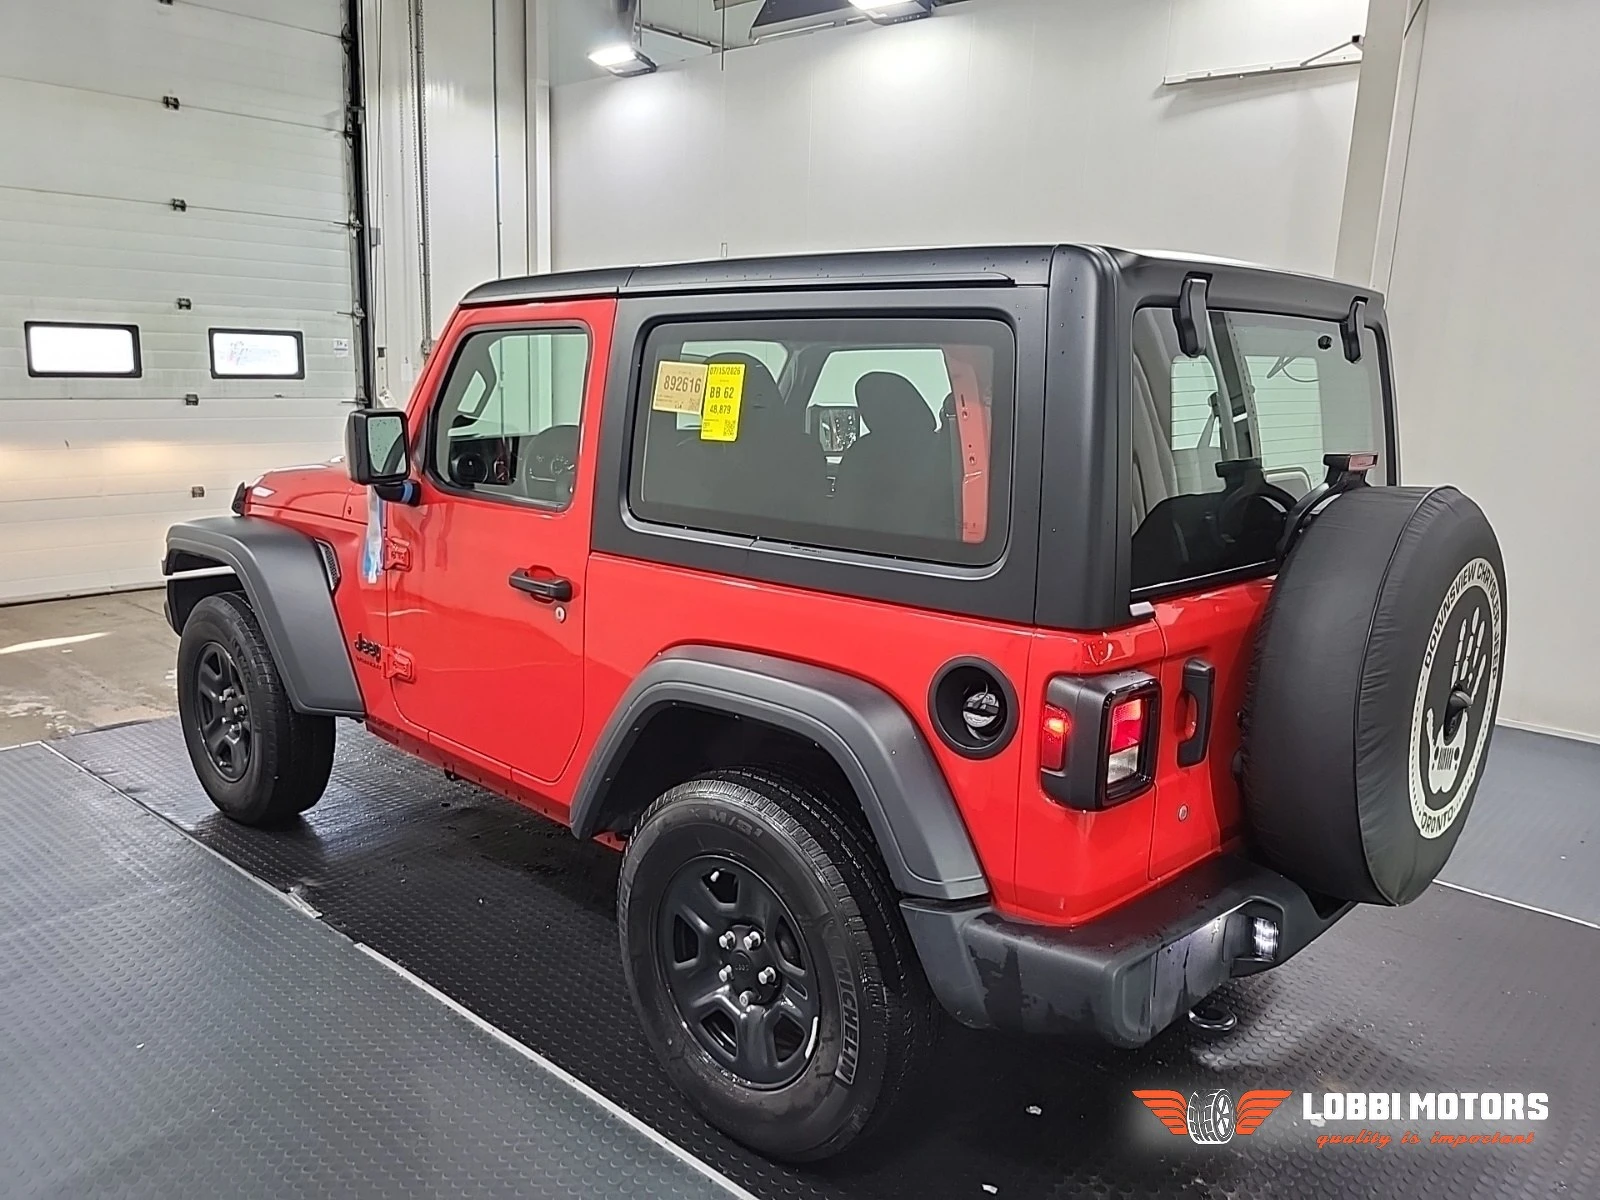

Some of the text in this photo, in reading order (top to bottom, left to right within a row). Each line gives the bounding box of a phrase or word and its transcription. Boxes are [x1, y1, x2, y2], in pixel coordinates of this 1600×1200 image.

[663, 374, 702, 394] 892616
[709, 386, 735, 399] BB 62
[1423, 562, 1476, 669] DOWNSVIEW
[1477, 562, 1500, 627] CHRYSLER
[354, 631, 382, 663] Jeep
[1420, 805, 1454, 834] ORONTO
[831, 955, 859, 1085] MICHELIN
